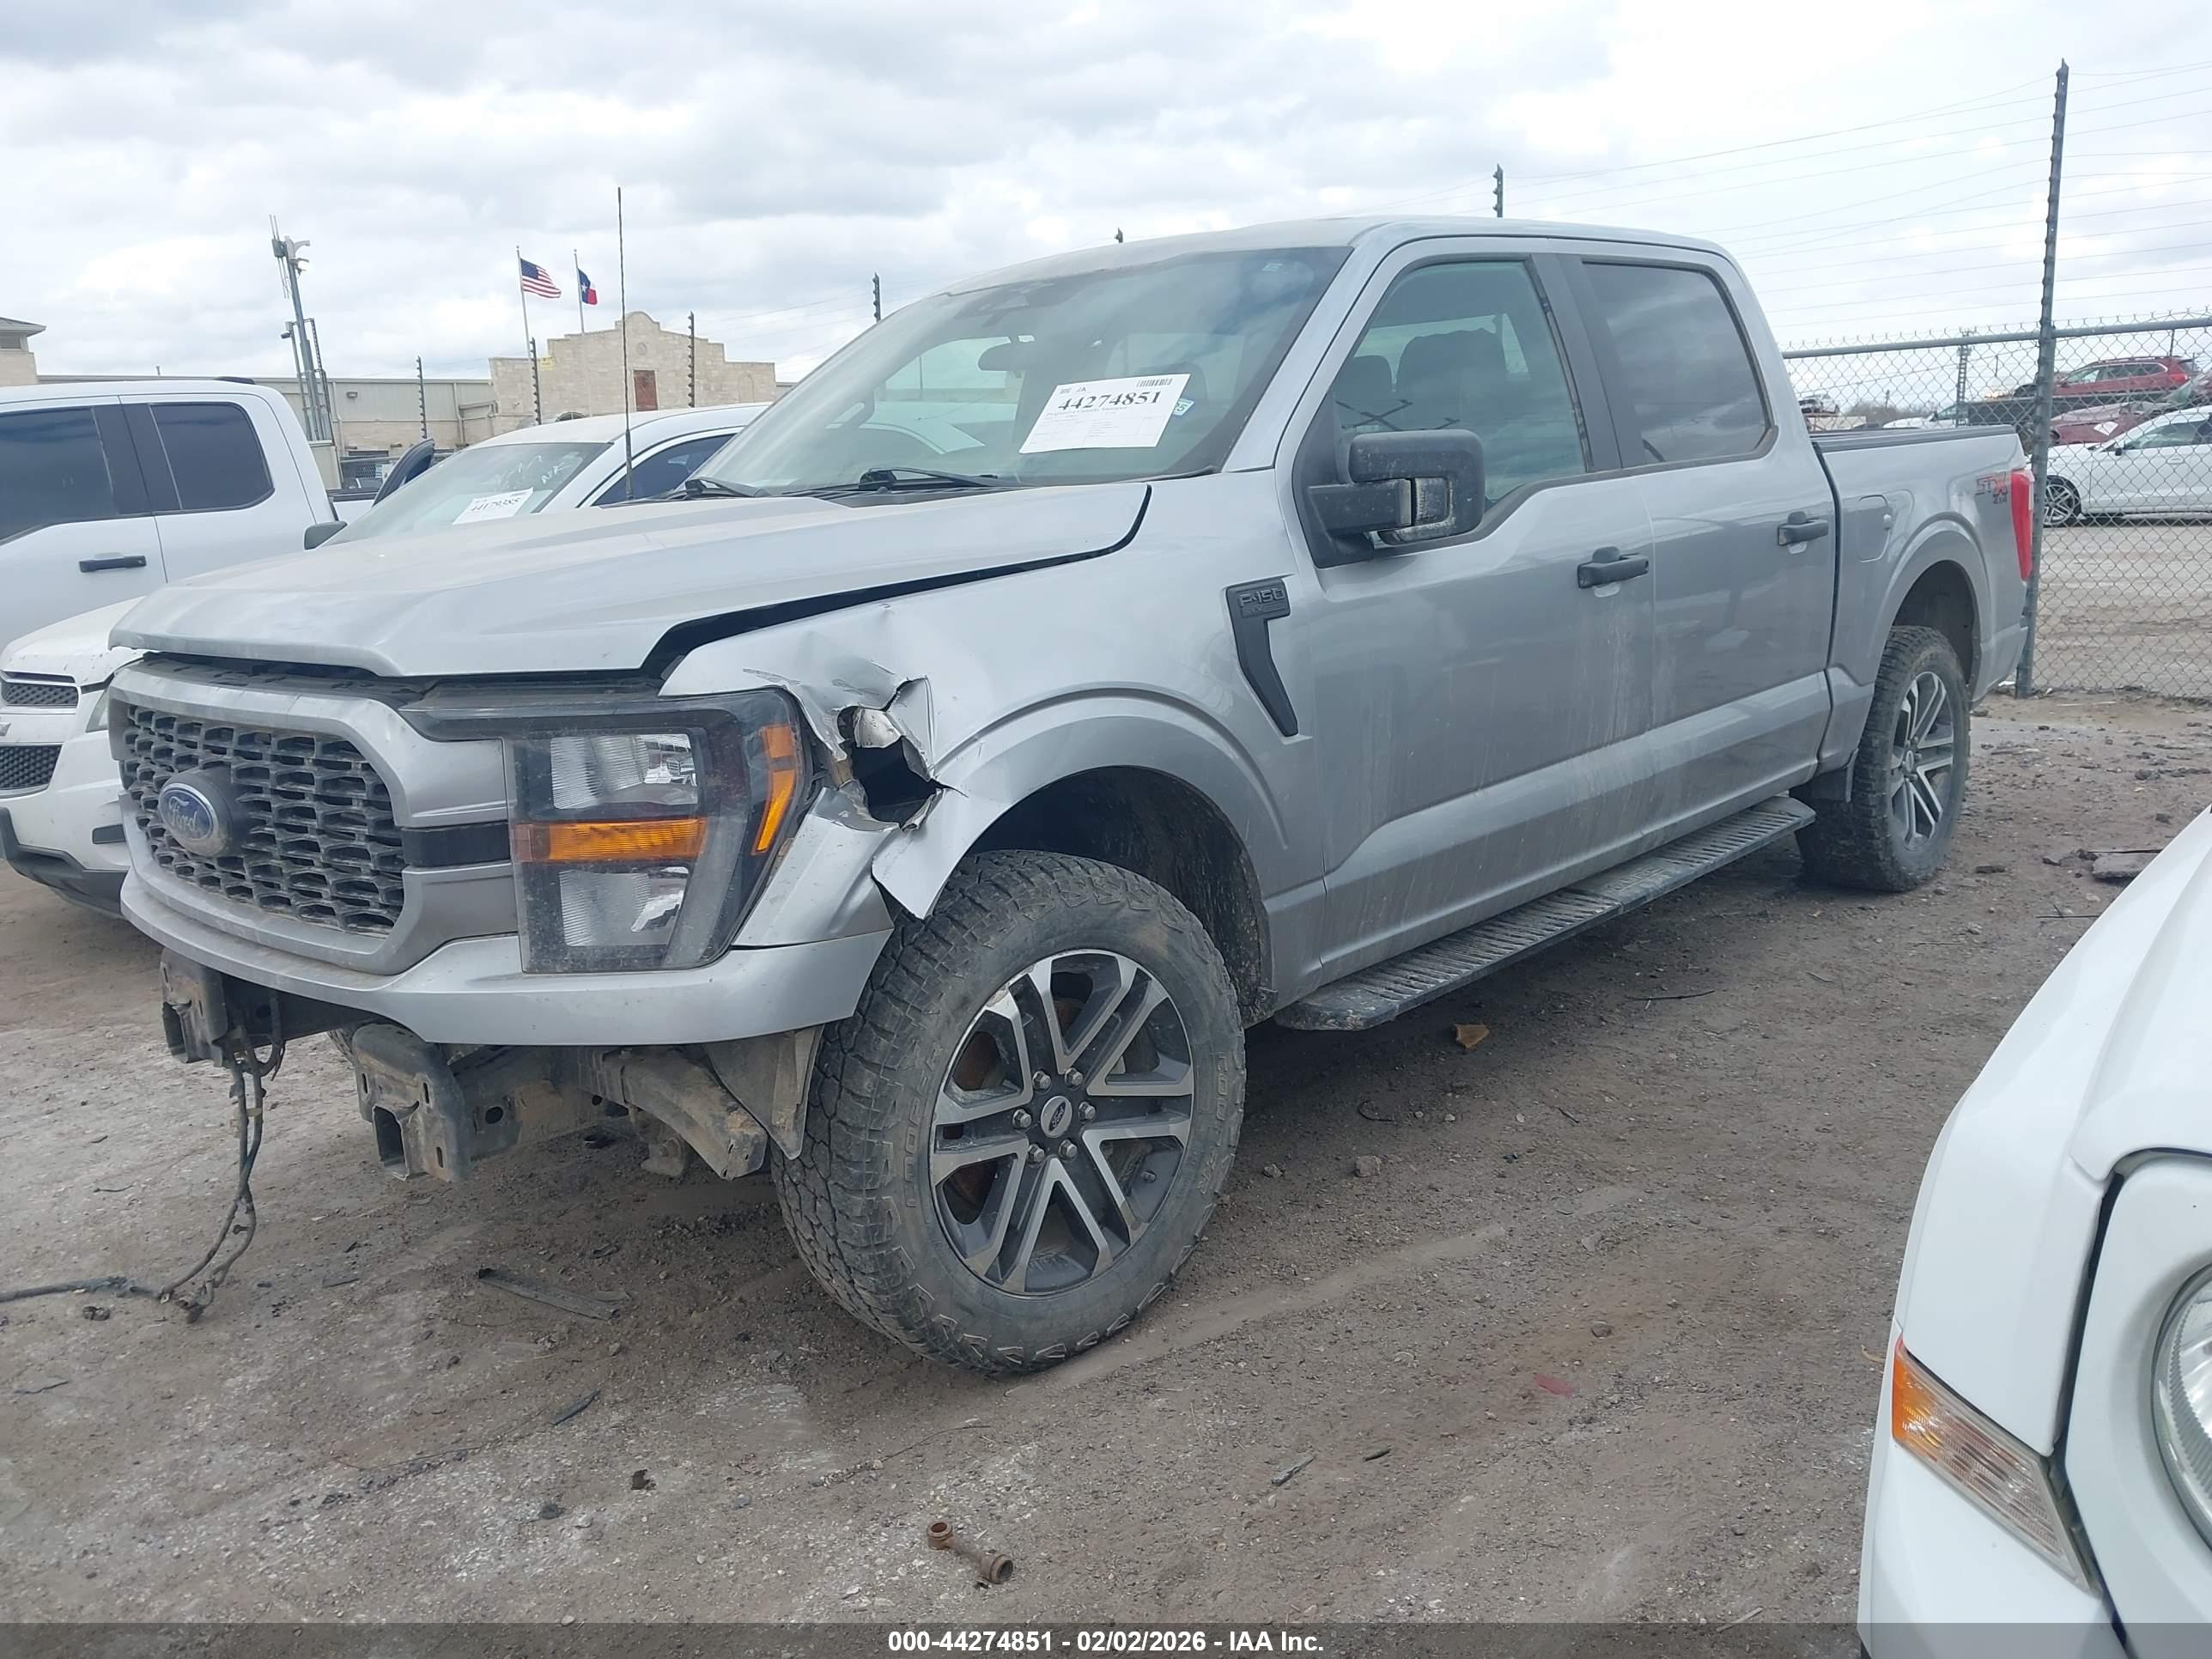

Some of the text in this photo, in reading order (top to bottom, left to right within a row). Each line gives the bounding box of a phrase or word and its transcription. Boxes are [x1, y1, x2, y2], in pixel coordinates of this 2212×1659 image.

[1057, 390, 1162, 411] 44274851
[1237, 587, 1285, 608] F-150
[167, 795, 198, 833] Ford
